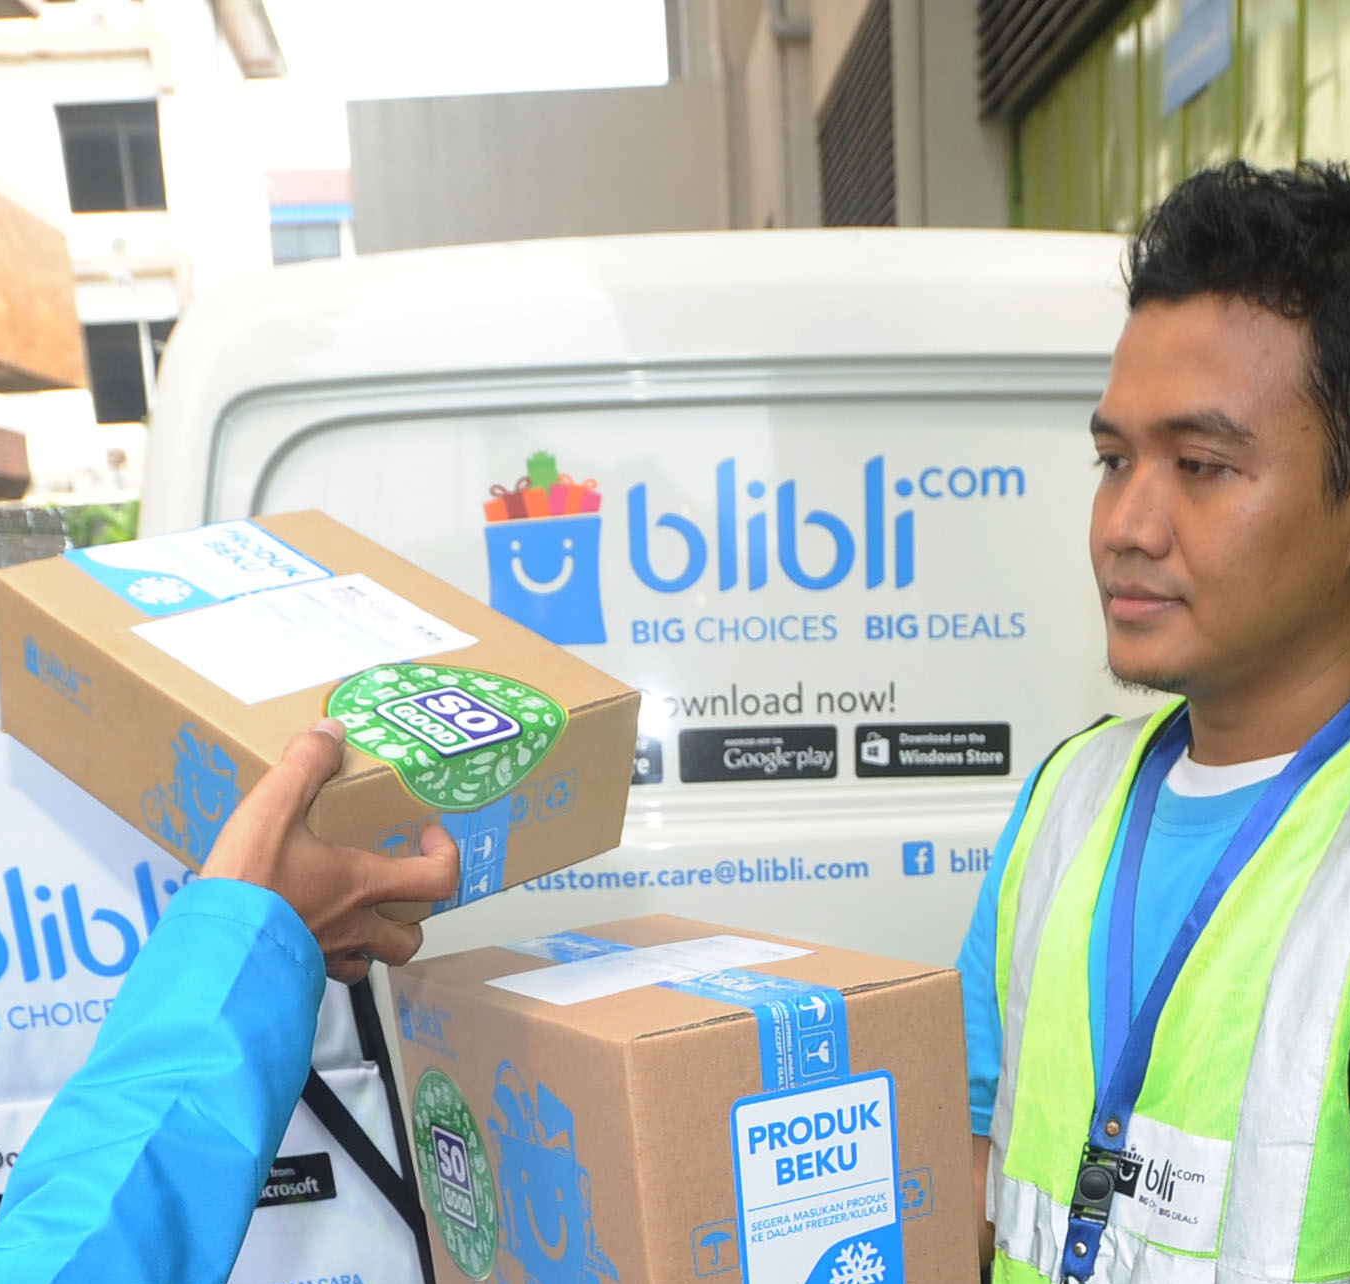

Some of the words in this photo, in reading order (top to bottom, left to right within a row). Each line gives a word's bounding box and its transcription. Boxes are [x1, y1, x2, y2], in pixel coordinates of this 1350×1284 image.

[631, 618, 685, 643] BIG
[695, 614, 838, 642] CHOICES
[865, 613, 918, 640] BIG
[927, 611, 1025, 639] DEALS
[425, 694, 499, 732] SO
[663, 681, 804, 718] ownload
[817, 681, 896, 714] now!
[393, 705, 458, 744] GOOD
[899, 732, 951, 745] Download
[953, 734, 966, 744] on
[968, 732, 986, 743] the
[723, 746, 790, 774] Google
[796, 746, 834, 771] play
[899, 748, 963, 766] Windows
[966, 749, 1004, 765] Store
[523, 858, 870, 892] customer.care@blibli.com
[748, 1100, 882, 1155] PRODUK
[437, 1139, 467, 1184] SO
[775, 1142, 857, 1186] BEKU
[751, 1215, 791, 1232] SEGERA
[793, 1202, 844, 1220] MASUKAN
[846, 1192, 887, 1208] PRODUK
[751, 1232, 764, 1243] KE
[766, 1223, 803, 1240] DALAM
[805, 1202, 889, 1231] FREEZER/KULKAS
[1172, 1211, 1199, 1225] DEALS
